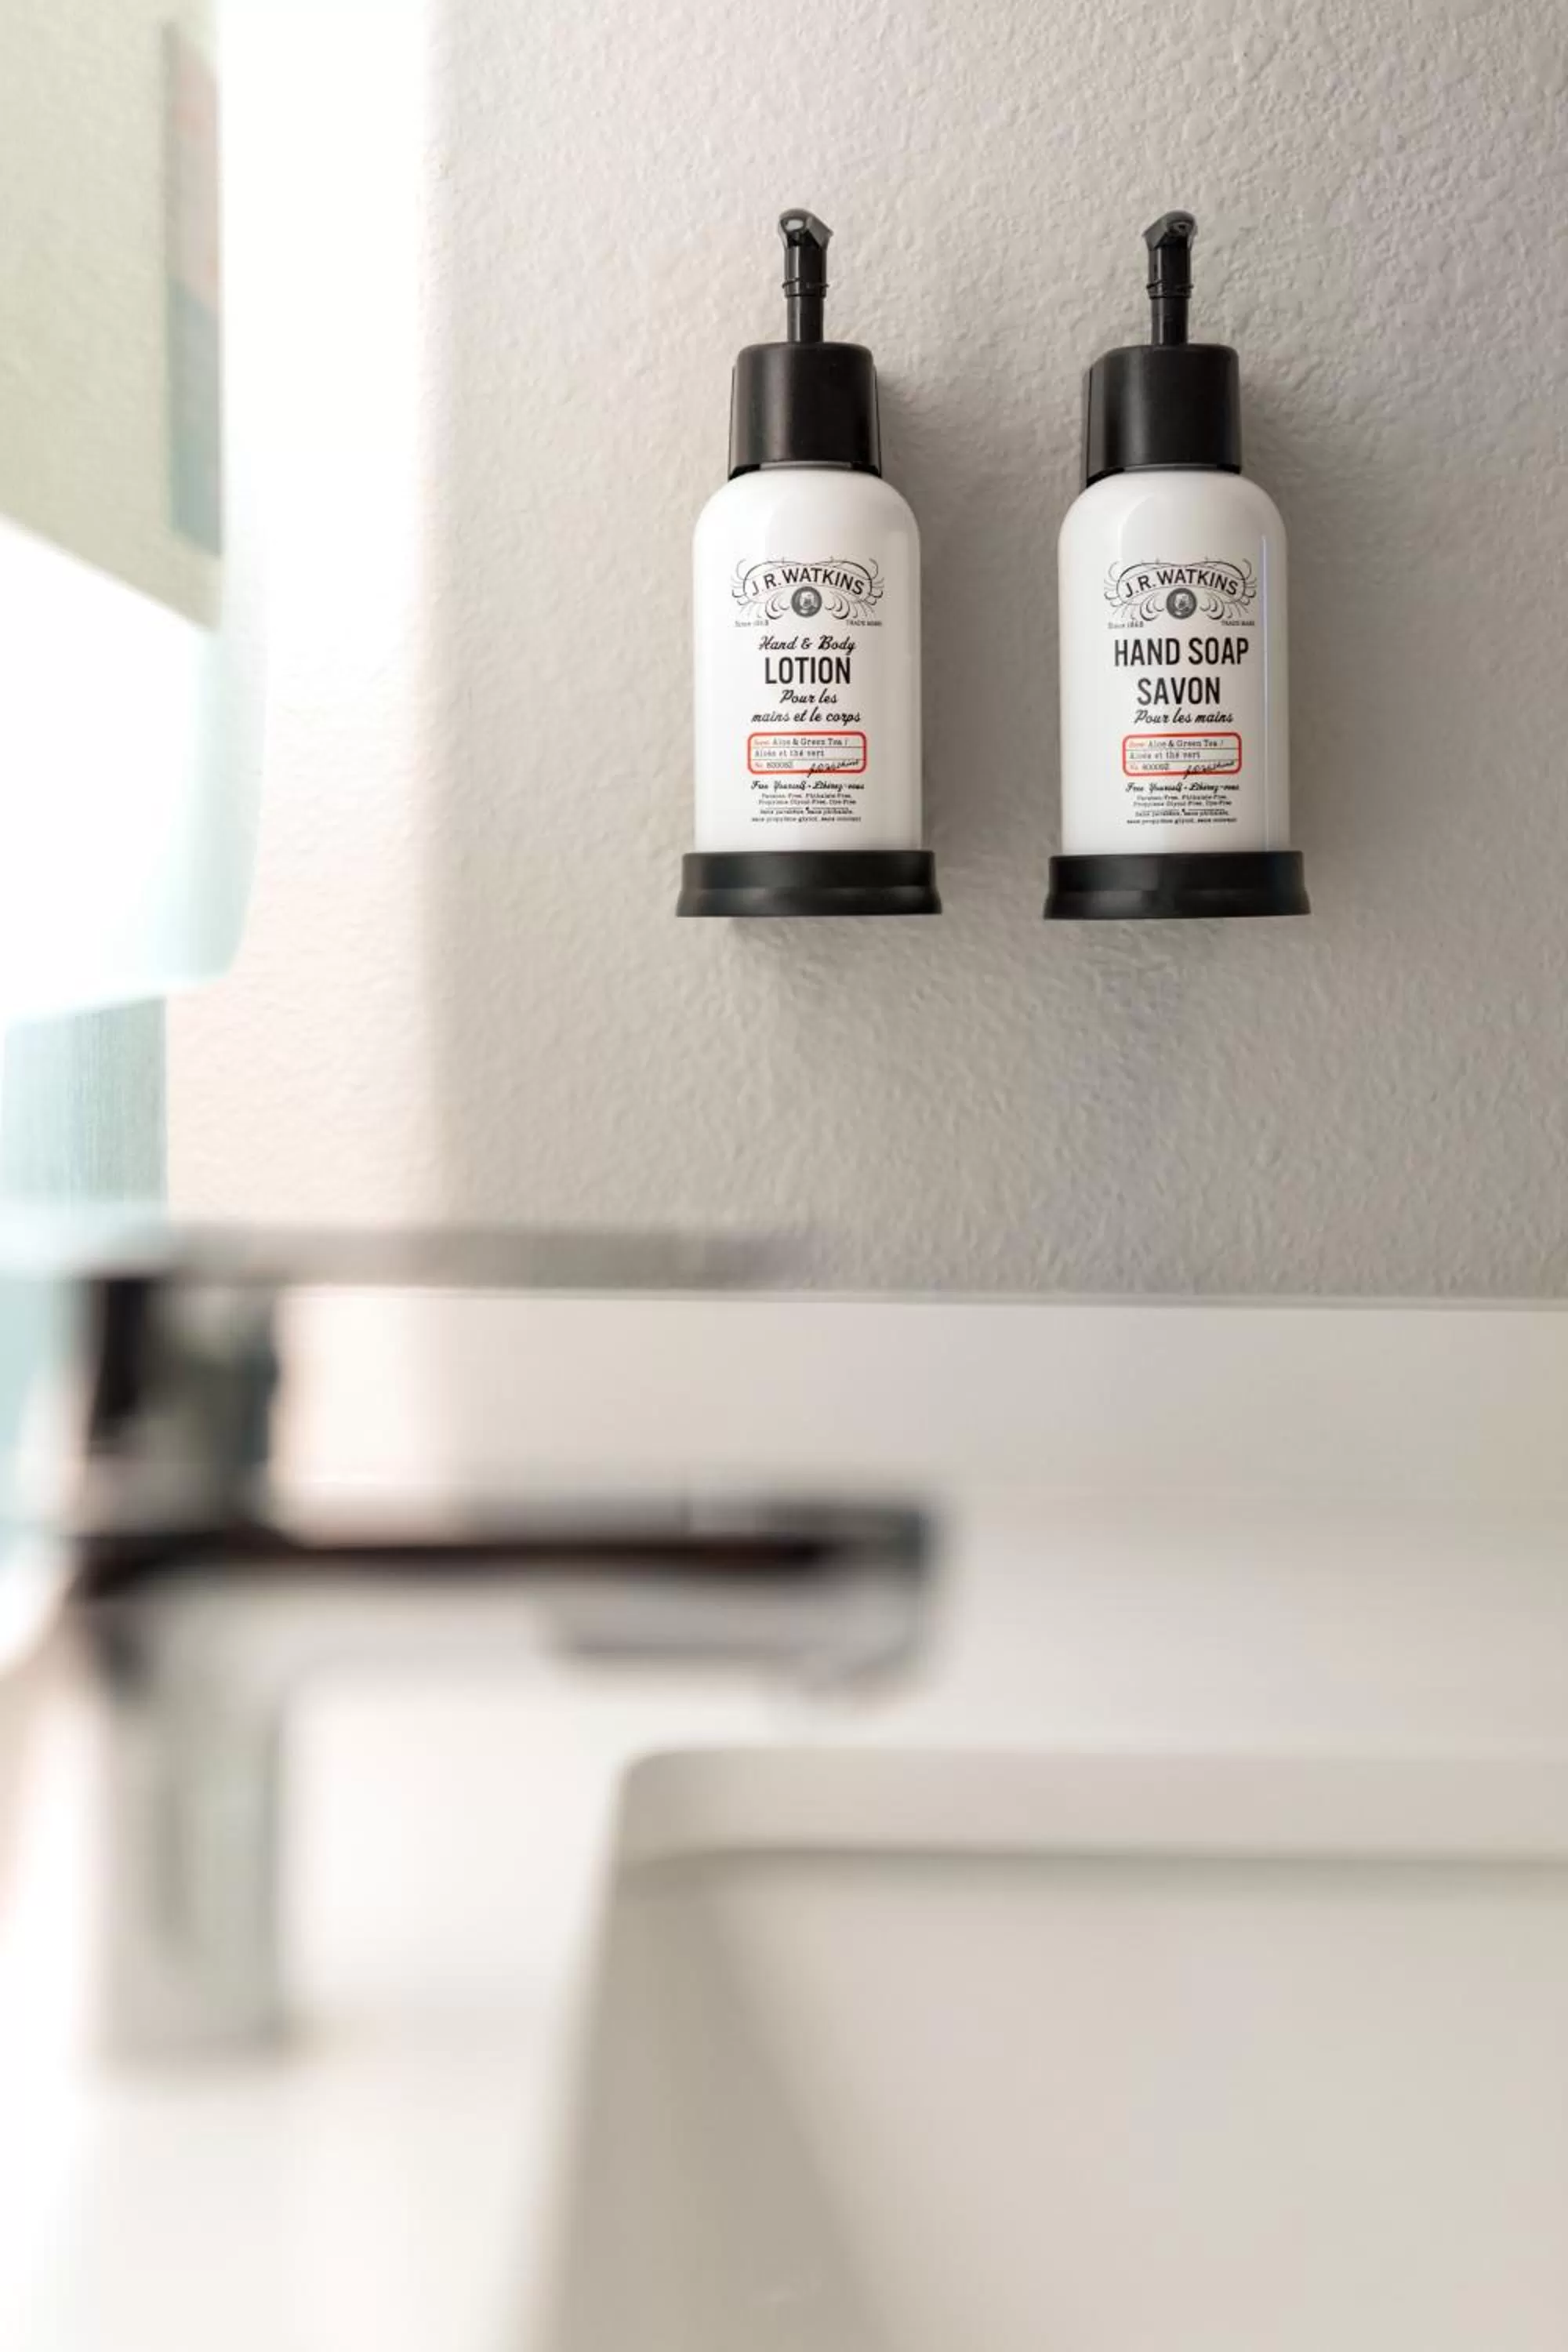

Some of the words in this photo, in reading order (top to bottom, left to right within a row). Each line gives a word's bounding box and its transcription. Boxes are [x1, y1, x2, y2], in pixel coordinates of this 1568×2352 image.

[782, 567, 865, 596] WATKINS
[1156, 568, 1239, 596] WATKINS
[758, 635, 799, 651] Hand
[800, 637, 812, 650] &
[818, 634, 856, 656] Body
[1114, 637, 1180, 666] HAND
[1188, 637, 1249, 666] SOAP
[764, 656, 851, 684] LOTION
[779, 688, 815, 704] Pour
[818, 688, 838, 704] les
[1137, 677, 1221, 706] SAVON
[751, 710, 790, 723] mains
[793, 709, 808, 722] et
[809, 706, 822, 722] le
[826, 711, 861, 726] corps
[1134, 709, 1170, 724] Pour
[1172, 707, 1192, 724] les
[1194, 711, 1234, 724] mains
